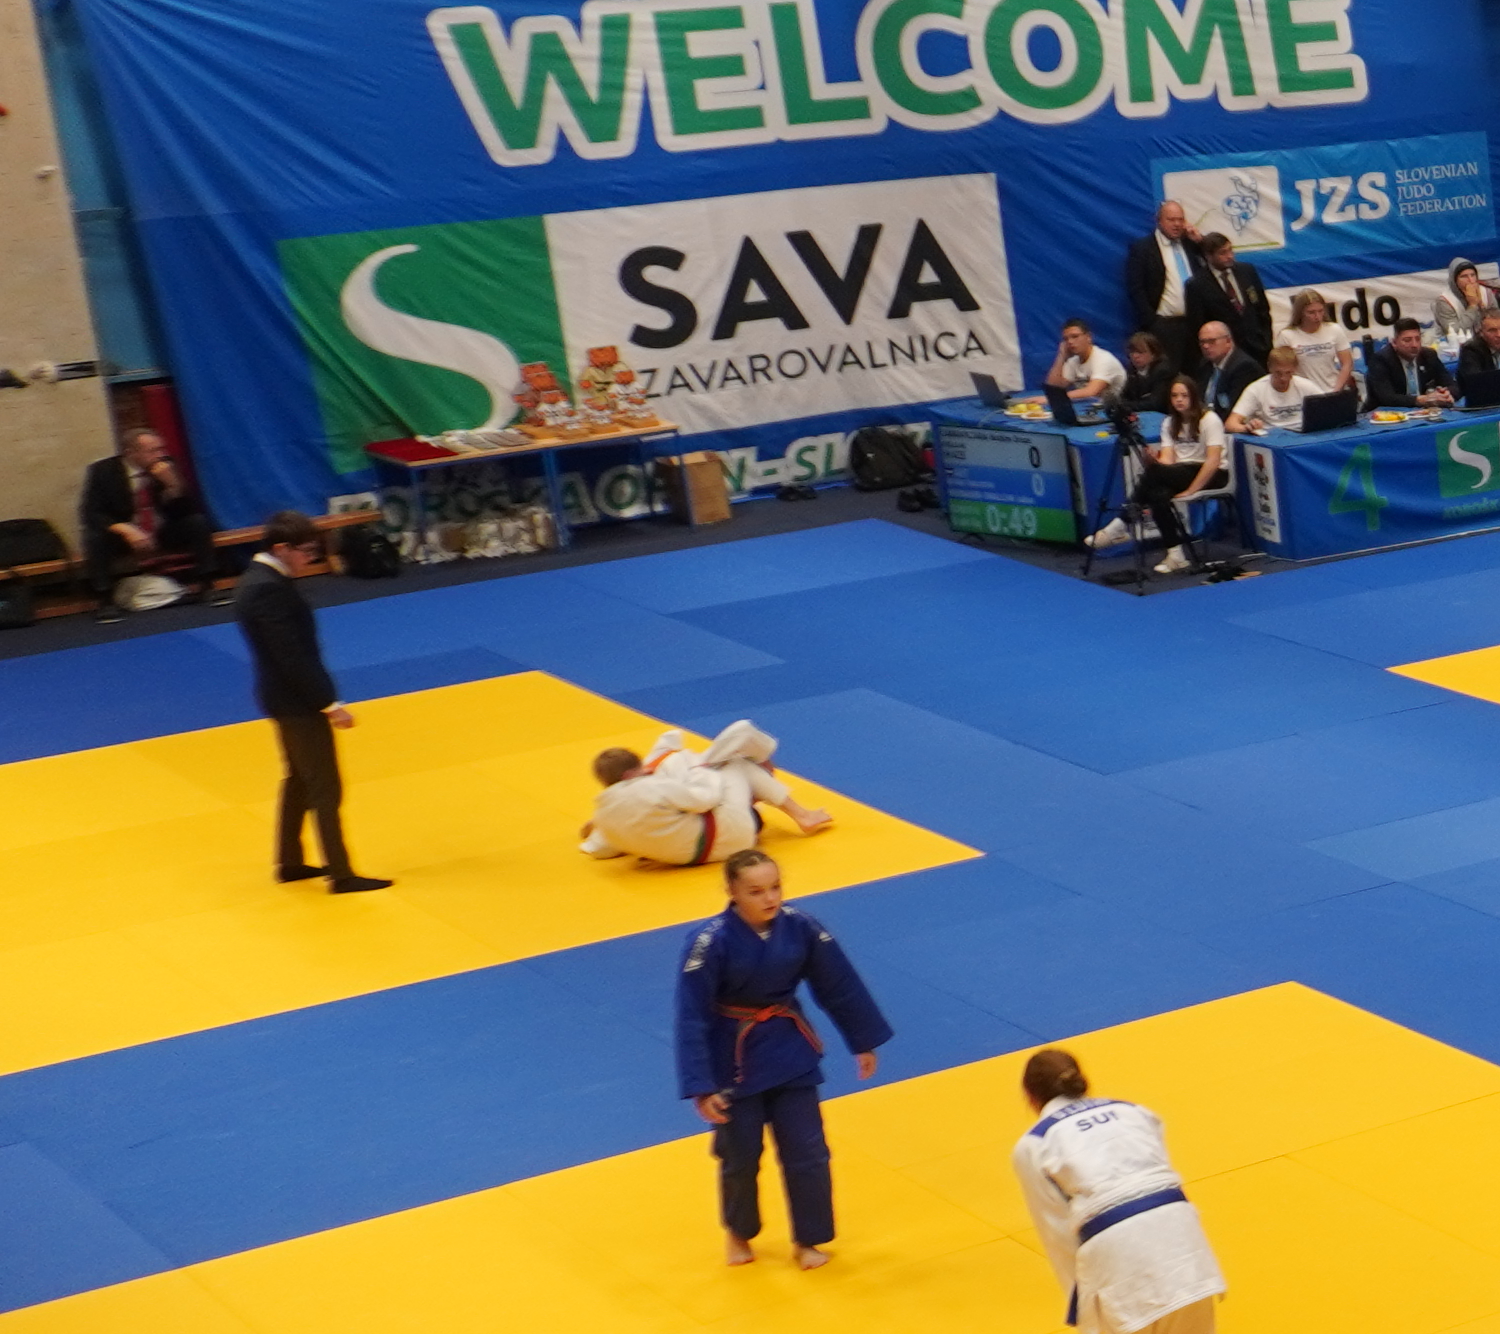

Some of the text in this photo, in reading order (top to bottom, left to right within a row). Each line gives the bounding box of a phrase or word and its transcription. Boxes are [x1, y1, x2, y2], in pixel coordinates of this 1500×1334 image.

[1290, 172, 1389, 231] JZS
[1395, 161, 1479, 184] SLOVENIAN
[1397, 182, 1435, 202] JUDO
[1400, 192, 1487, 217] FEDERATION
[619, 217, 980, 349] SAVA
[640, 331, 988, 399] ZAVAROVALNICA
[1329, 444, 1389, 532] 4
